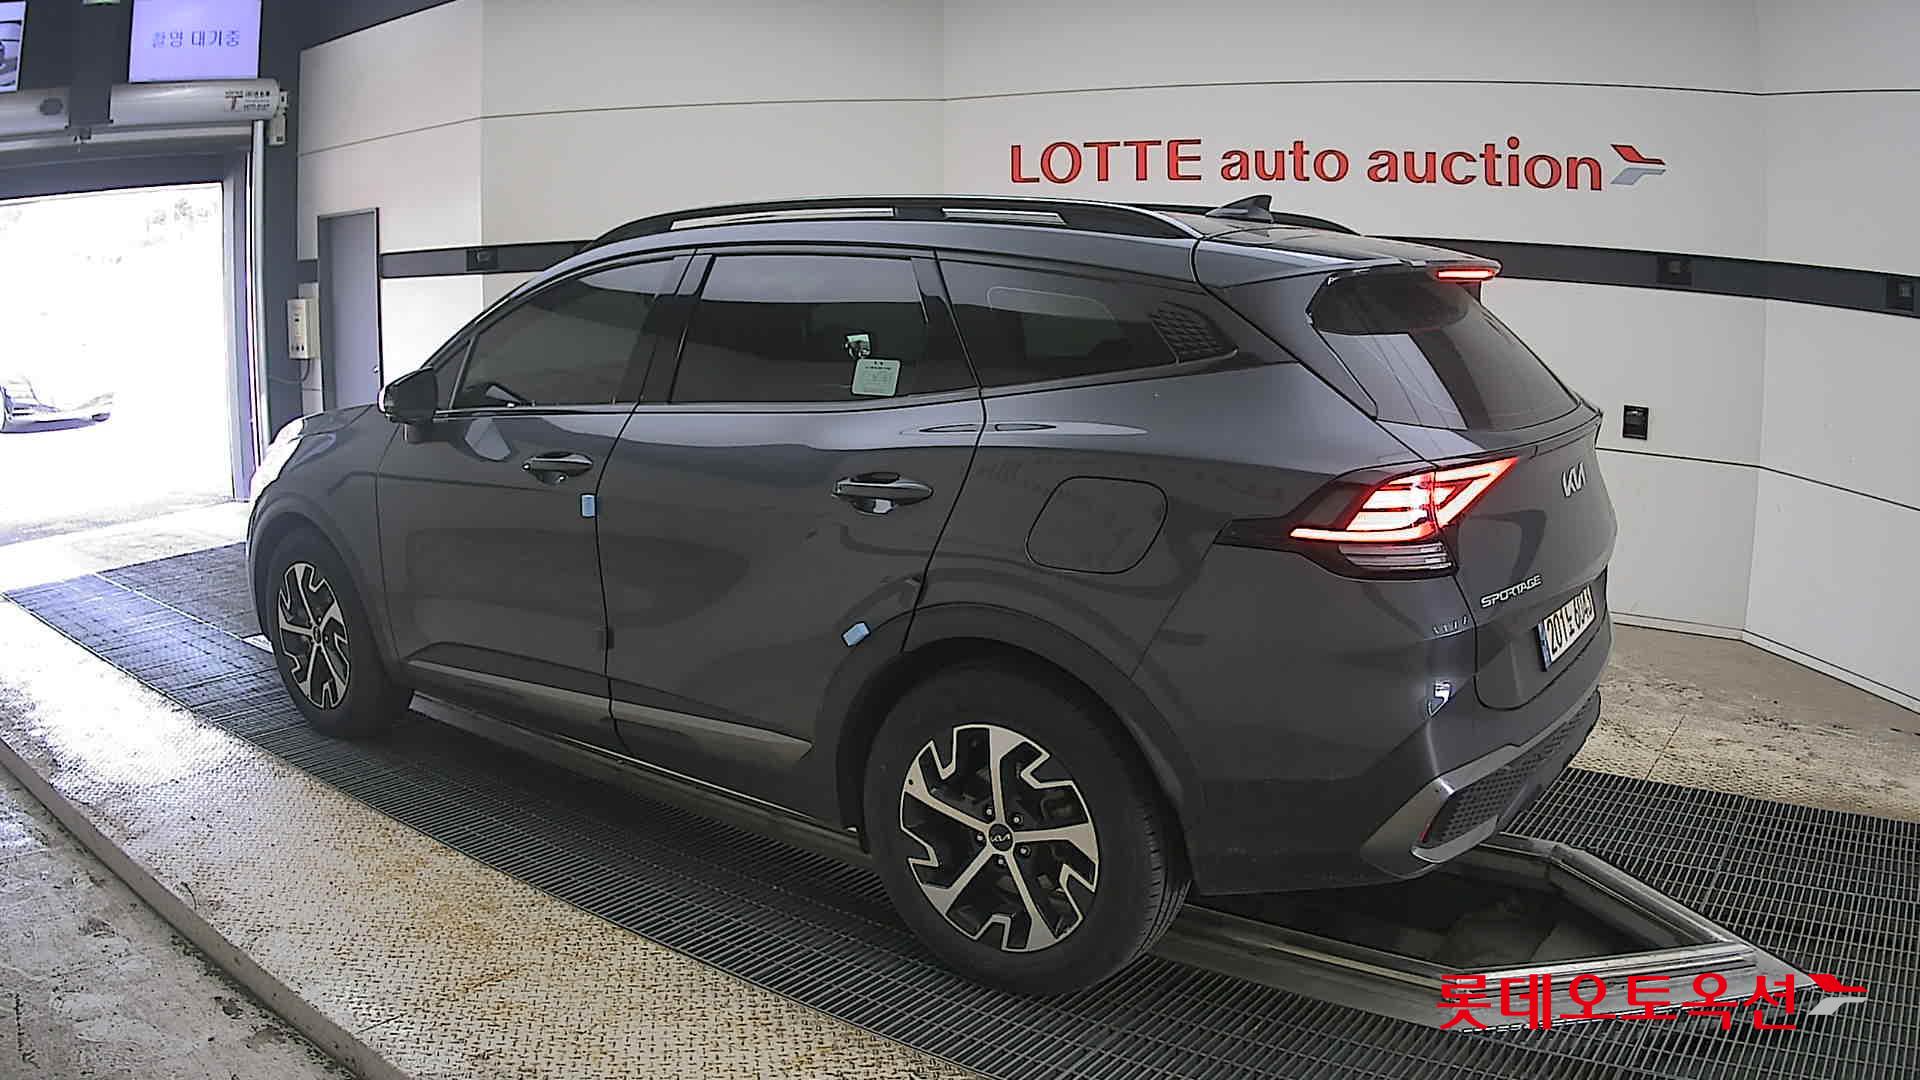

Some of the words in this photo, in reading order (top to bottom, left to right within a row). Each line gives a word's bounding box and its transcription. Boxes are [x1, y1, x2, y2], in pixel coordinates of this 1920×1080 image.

[191, 30, 241, 48] 대기중
[1010, 139, 1202, 184] LOTTE
[1219, 140, 1349, 183] auto
[1366, 136, 1603, 191] auction
[1480, 573, 1543, 609] SPORTAGE
